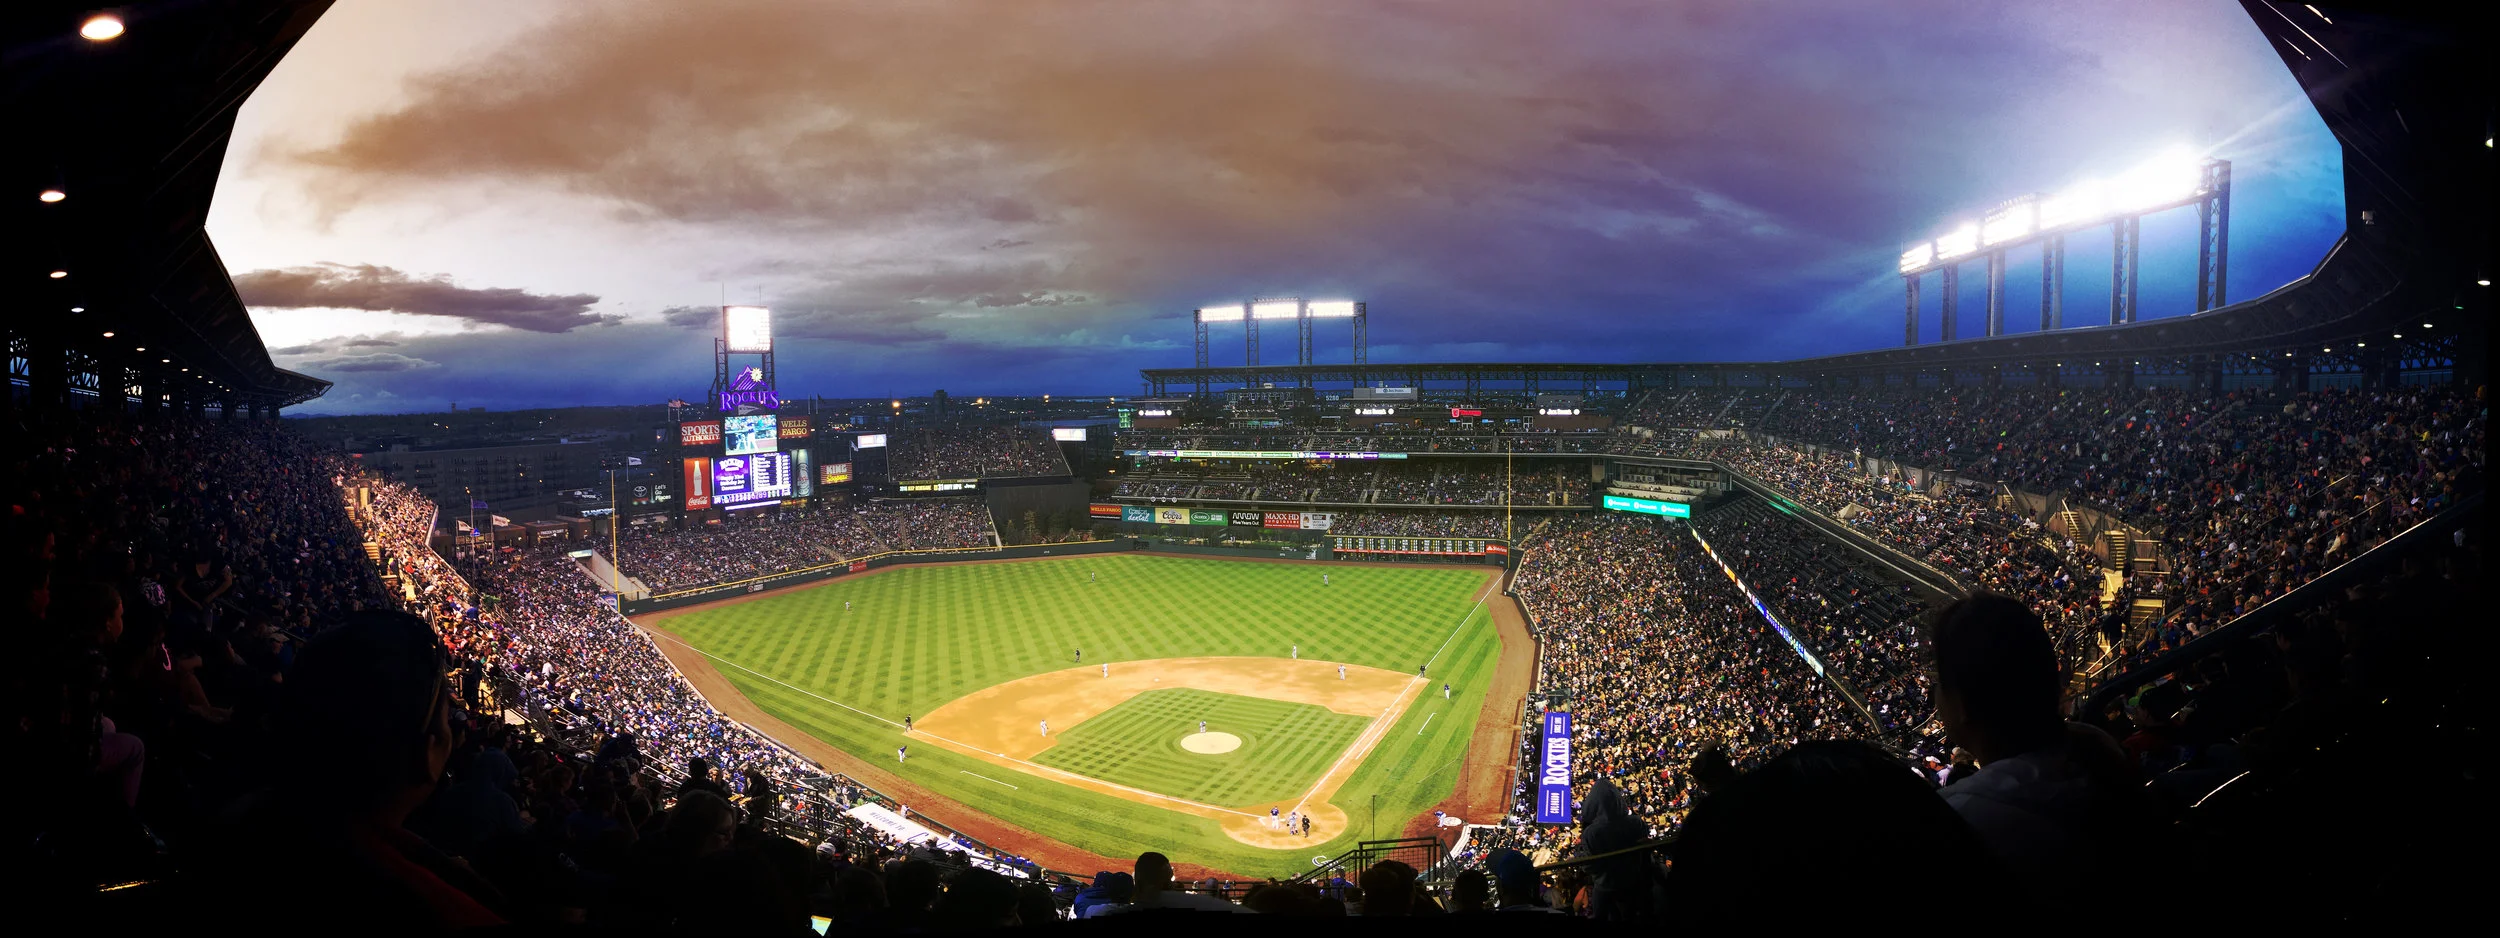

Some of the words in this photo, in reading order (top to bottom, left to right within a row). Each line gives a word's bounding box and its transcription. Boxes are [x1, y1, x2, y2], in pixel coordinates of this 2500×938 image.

[719, 391, 779, 411] ROCKIES
[781, 420, 807, 428] WELLS
[681, 424, 720, 436] SPORTS
[782, 428, 807, 436] FARGO
[682, 433, 720, 443] AUTHORITY
[826, 464, 848, 475] KING
[1127, 513, 1150, 522] dental
[1162, 510, 1182, 520] Coors
[1232, 512, 1259, 520] ARROW
[1542, 737, 1570, 786] ROCKIES
[1550, 792, 1560, 814] COLORADO
[870, 812, 896, 827] WELCOME
